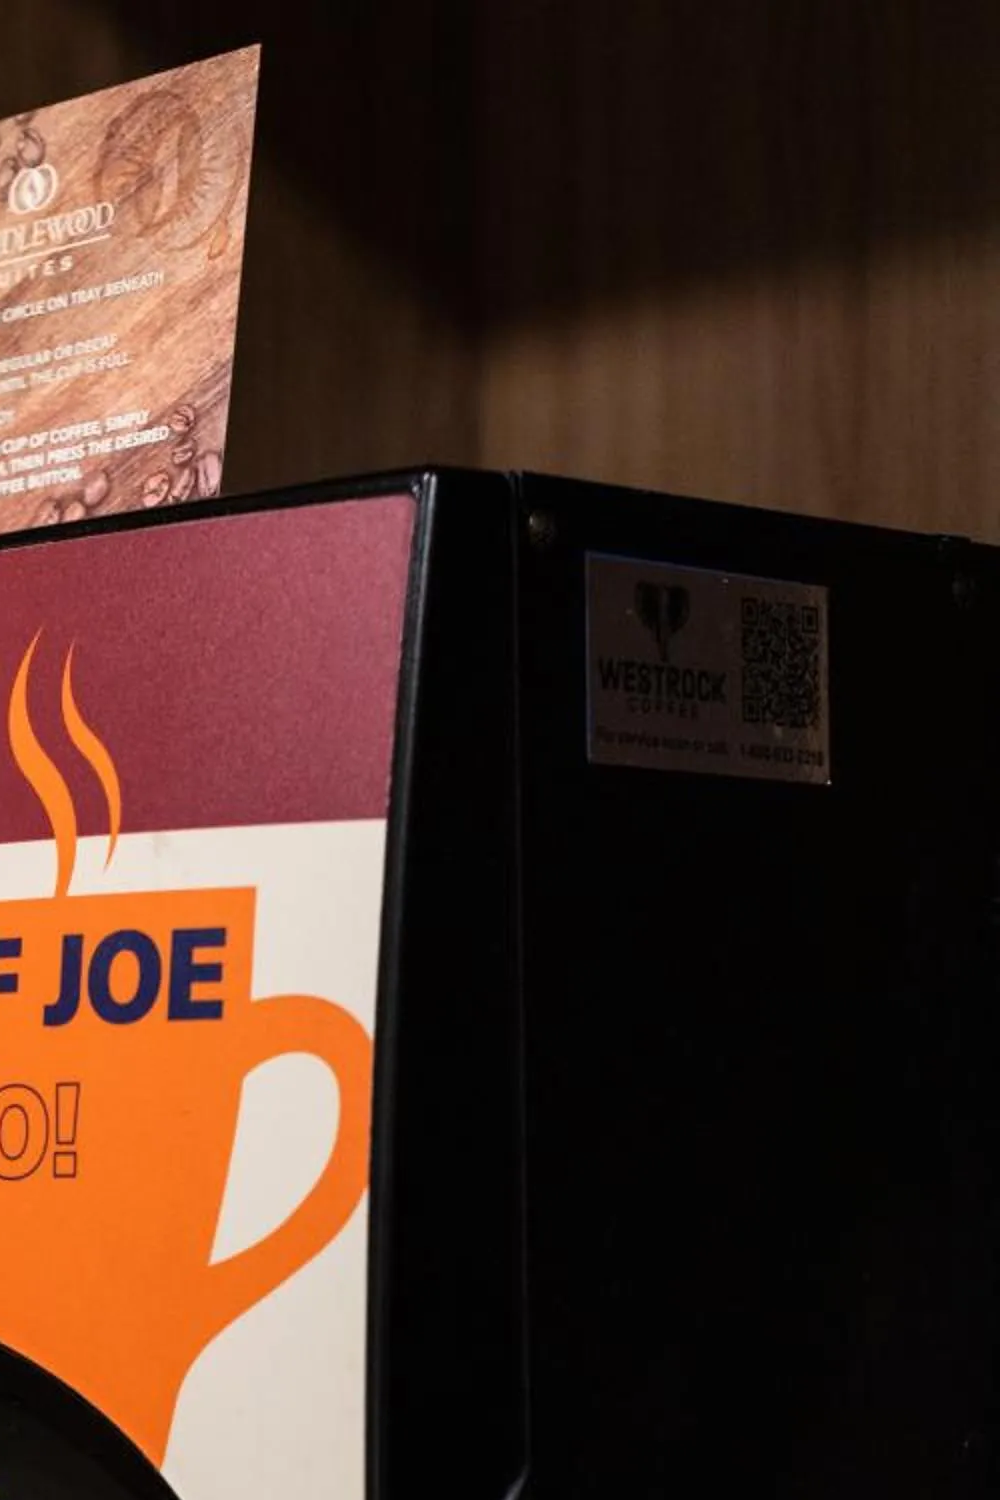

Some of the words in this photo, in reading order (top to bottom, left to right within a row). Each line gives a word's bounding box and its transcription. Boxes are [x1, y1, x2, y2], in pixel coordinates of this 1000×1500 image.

[47, 293, 69, 312] ON
[70, 286, 103, 305] TRAY
[30, 431, 49, 449] OF
[87, 437, 114, 456] THE
[115, 425, 170, 450] DESIRED
[597, 656, 727, 704] WESTROCK
[626, 697, 699, 721] COFFEE
[42, 927, 228, 1027] JOE
